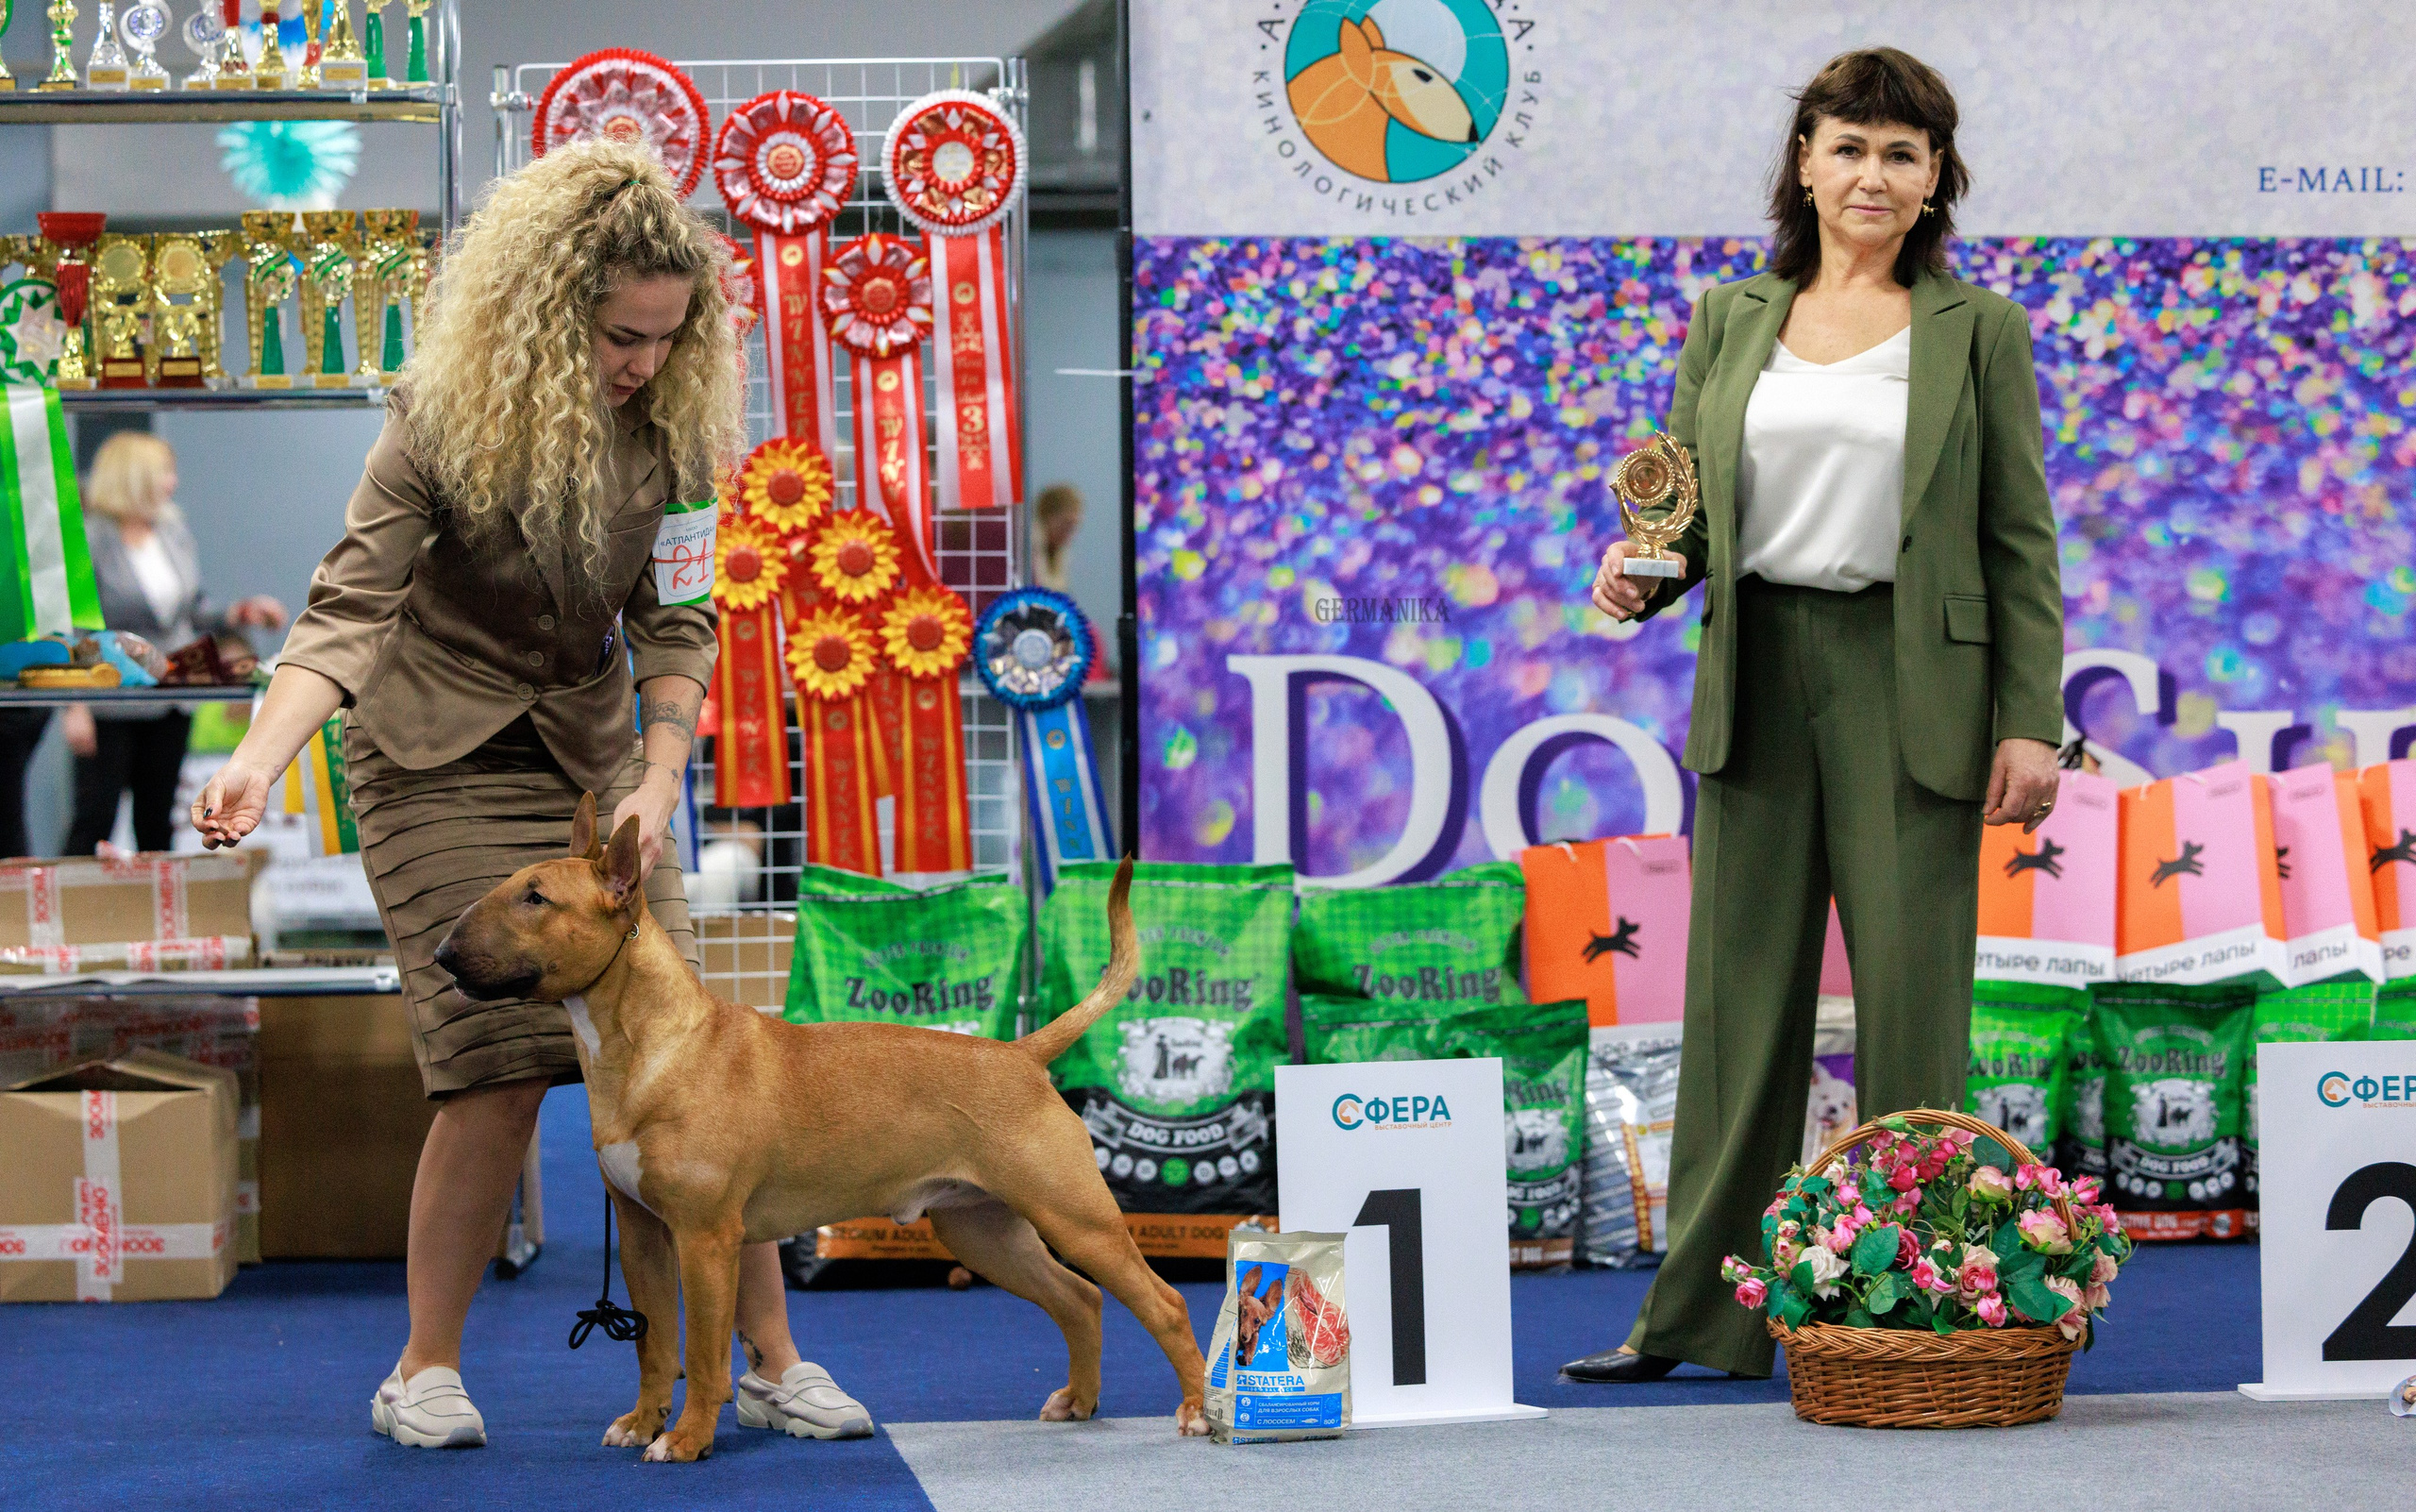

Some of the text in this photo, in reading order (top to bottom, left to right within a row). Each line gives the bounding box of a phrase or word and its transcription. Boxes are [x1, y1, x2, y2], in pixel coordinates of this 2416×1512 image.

[1252, 69, 1541, 217] КИНОЛОГИЧЕСКИЙ КЛУБ
[2257, 166, 2404, 193] E-MAIL:
[2046, 956, 2106, 976] лапы
[2200, 942, 2257, 967] лапы
[2293, 943, 2348, 969] лапы
[846, 976, 996, 1016] ZooRing
[1101, 965, 1253, 1013] ooRing
[1351, 964, 1502, 1003] ZooRing
[2117, 1046, 2227, 1079] ZooRing
[1332, 1093, 1451, 1131] СФЕРА
[1374, 1121, 1452, 1131] ВЫСТАВОЧНЫЙ ЦЕНТР
[1127, 1121, 1225, 1146] DOG FOOD
[2322, 1161, 2416, 1362] 2
[1352, 1187, 1427, 1386] 1
[1248, 1374, 1305, 1386] STATERA
